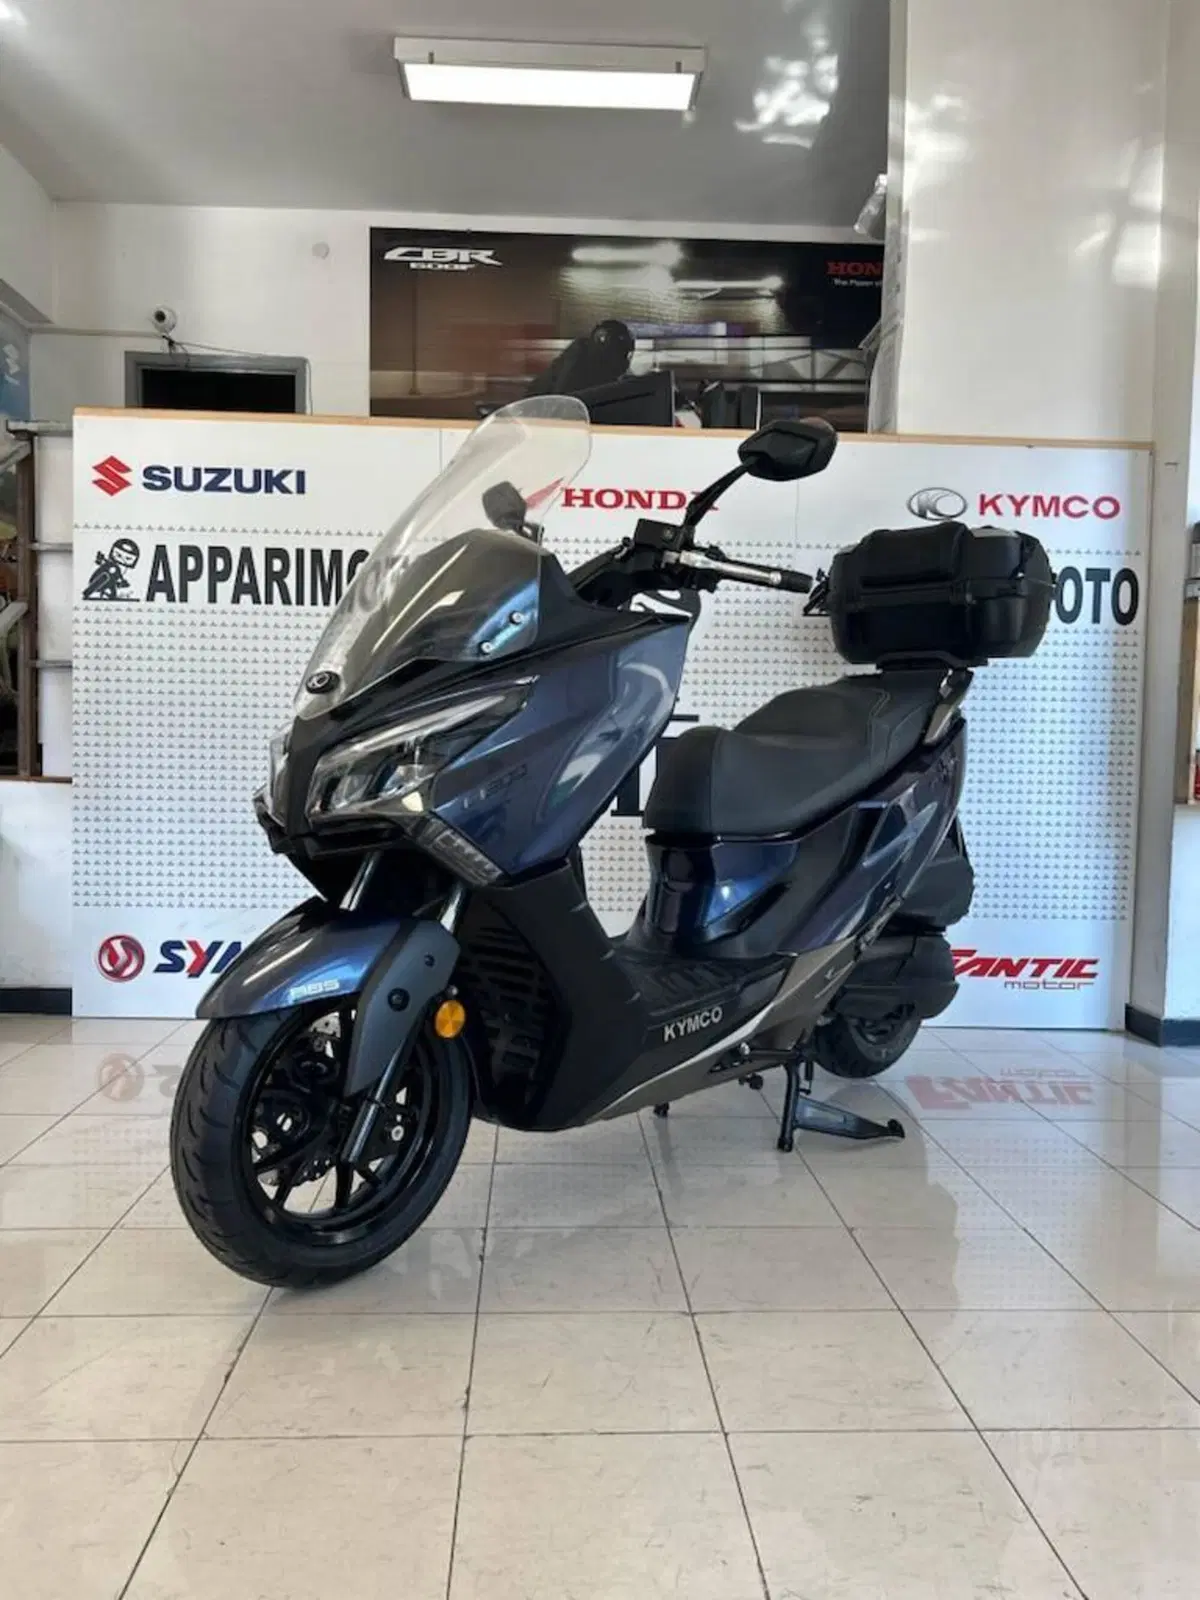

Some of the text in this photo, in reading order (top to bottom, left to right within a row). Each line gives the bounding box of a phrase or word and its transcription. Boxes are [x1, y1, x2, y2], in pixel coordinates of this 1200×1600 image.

[384, 246, 503, 266] CBR
[142, 465, 306, 495] SUZUKI
[561, 488, 719, 511] HOND
[979, 494, 1121, 520] KYMCO
[1004, 980, 1094, 990] motor
[664, 1006, 723, 1042] KYMCO
